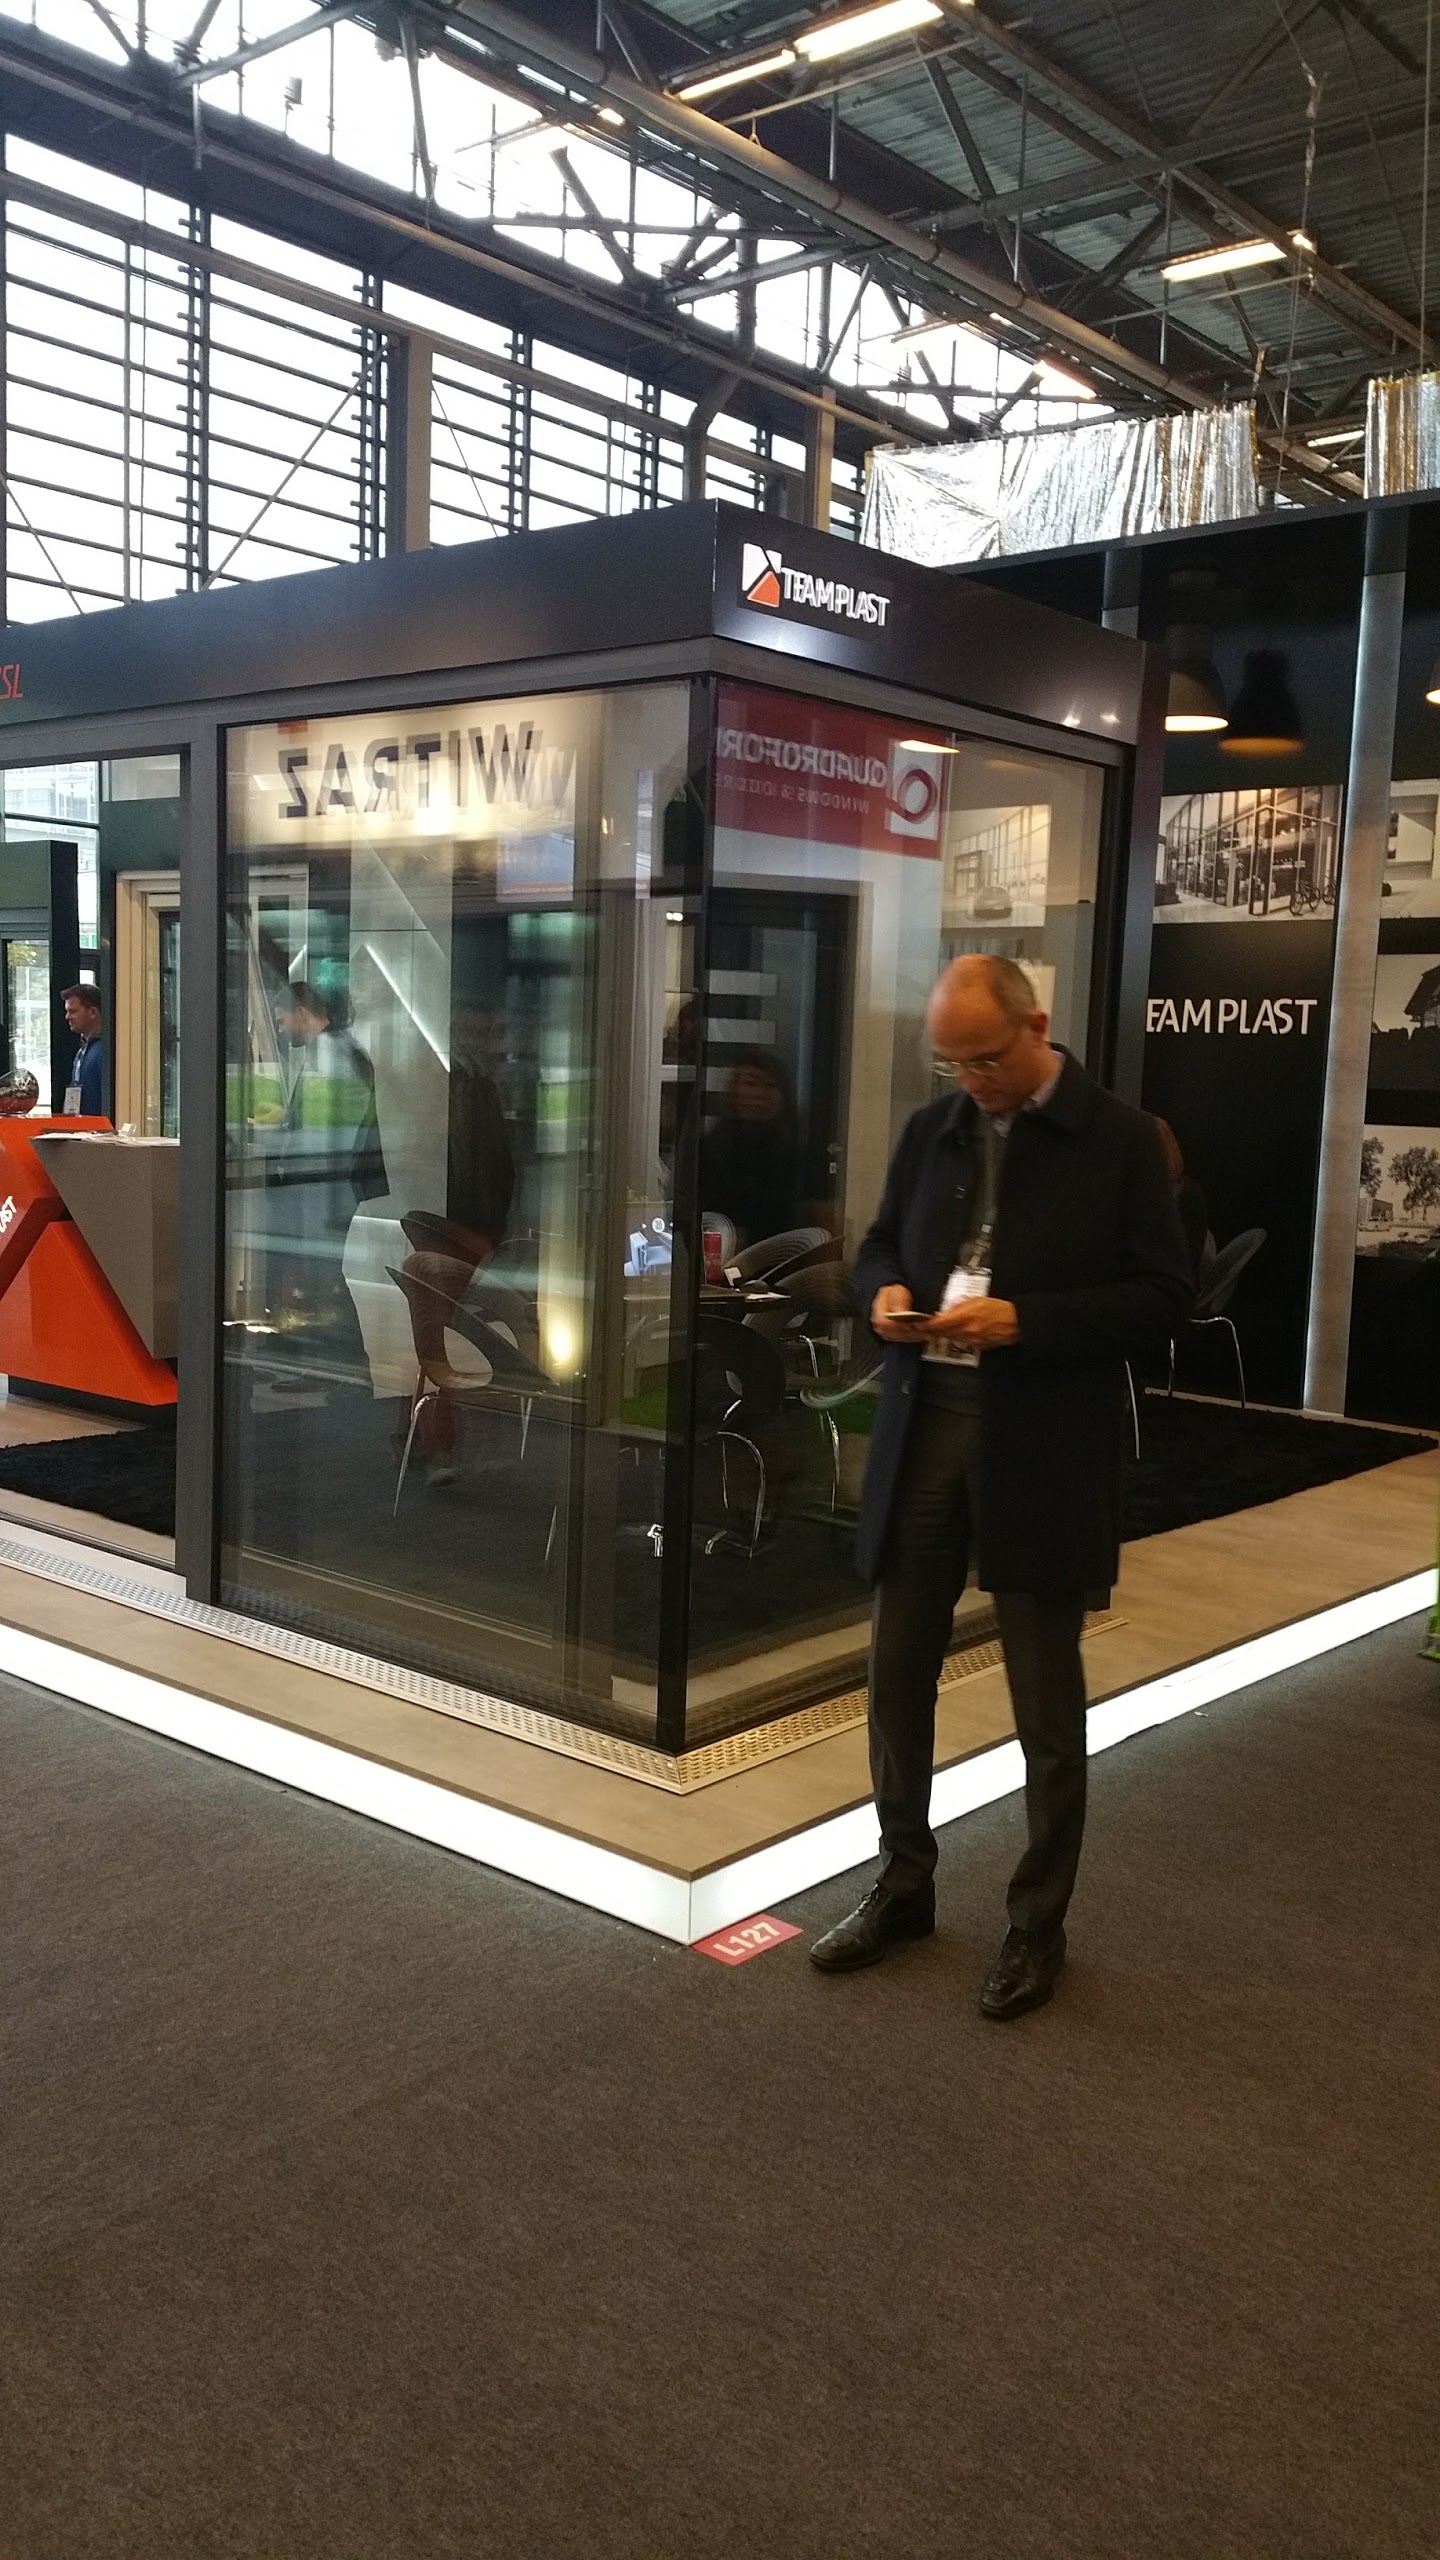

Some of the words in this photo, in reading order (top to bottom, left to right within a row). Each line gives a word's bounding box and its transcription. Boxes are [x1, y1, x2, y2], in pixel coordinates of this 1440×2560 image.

[781, 567, 890, 626] TEAMPLAST
[1146, 997, 1318, 1035] EAMPLAST
[713, 1921, 781, 1957] L127
